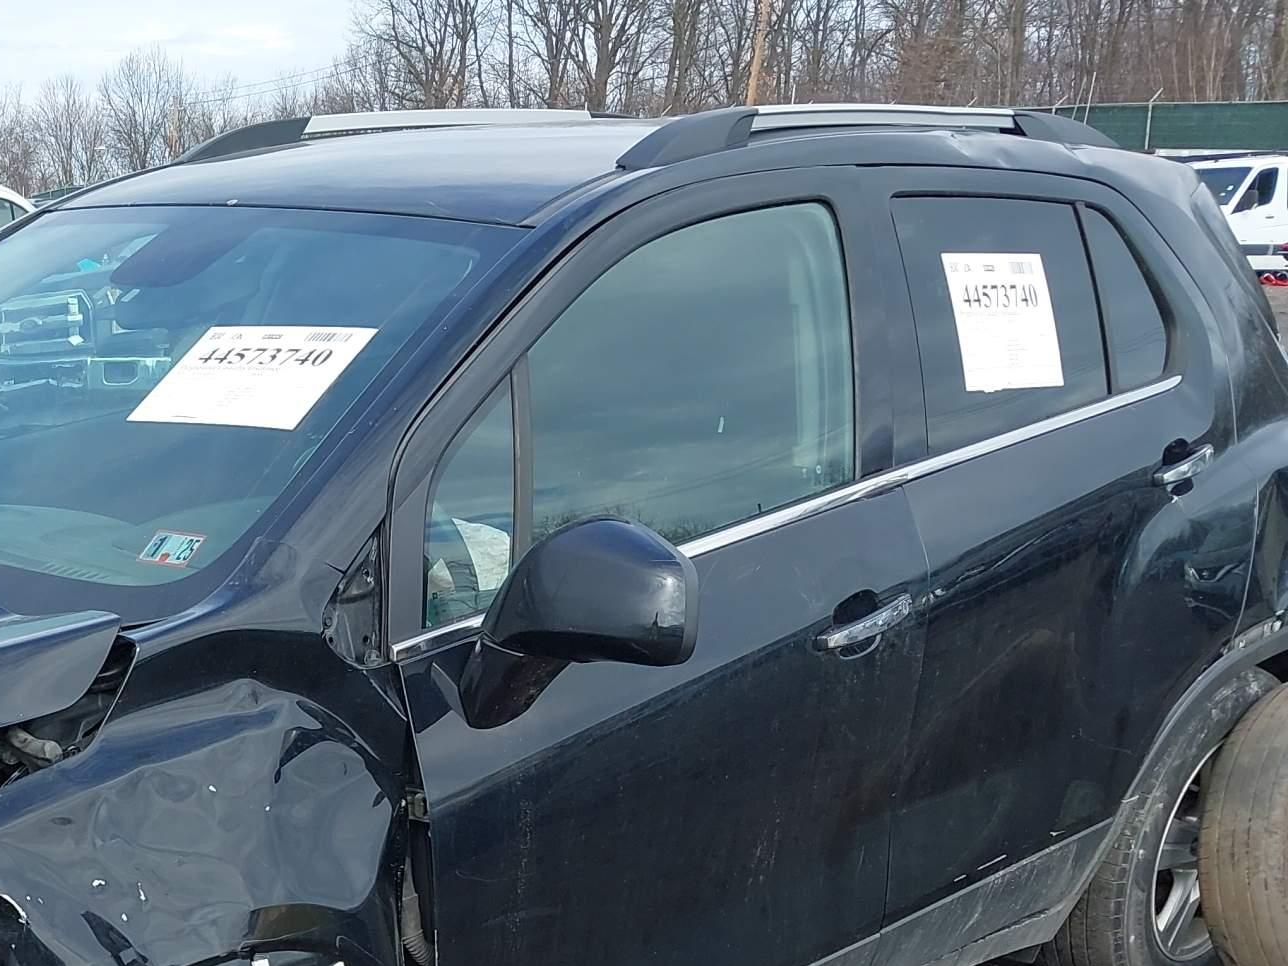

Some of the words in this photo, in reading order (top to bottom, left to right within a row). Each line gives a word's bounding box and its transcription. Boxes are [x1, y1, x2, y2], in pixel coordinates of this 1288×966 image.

[962, 284, 1039, 308] 44573740
[198, 348, 334, 367] 44573740
[175, 539, 201, 561] 25
